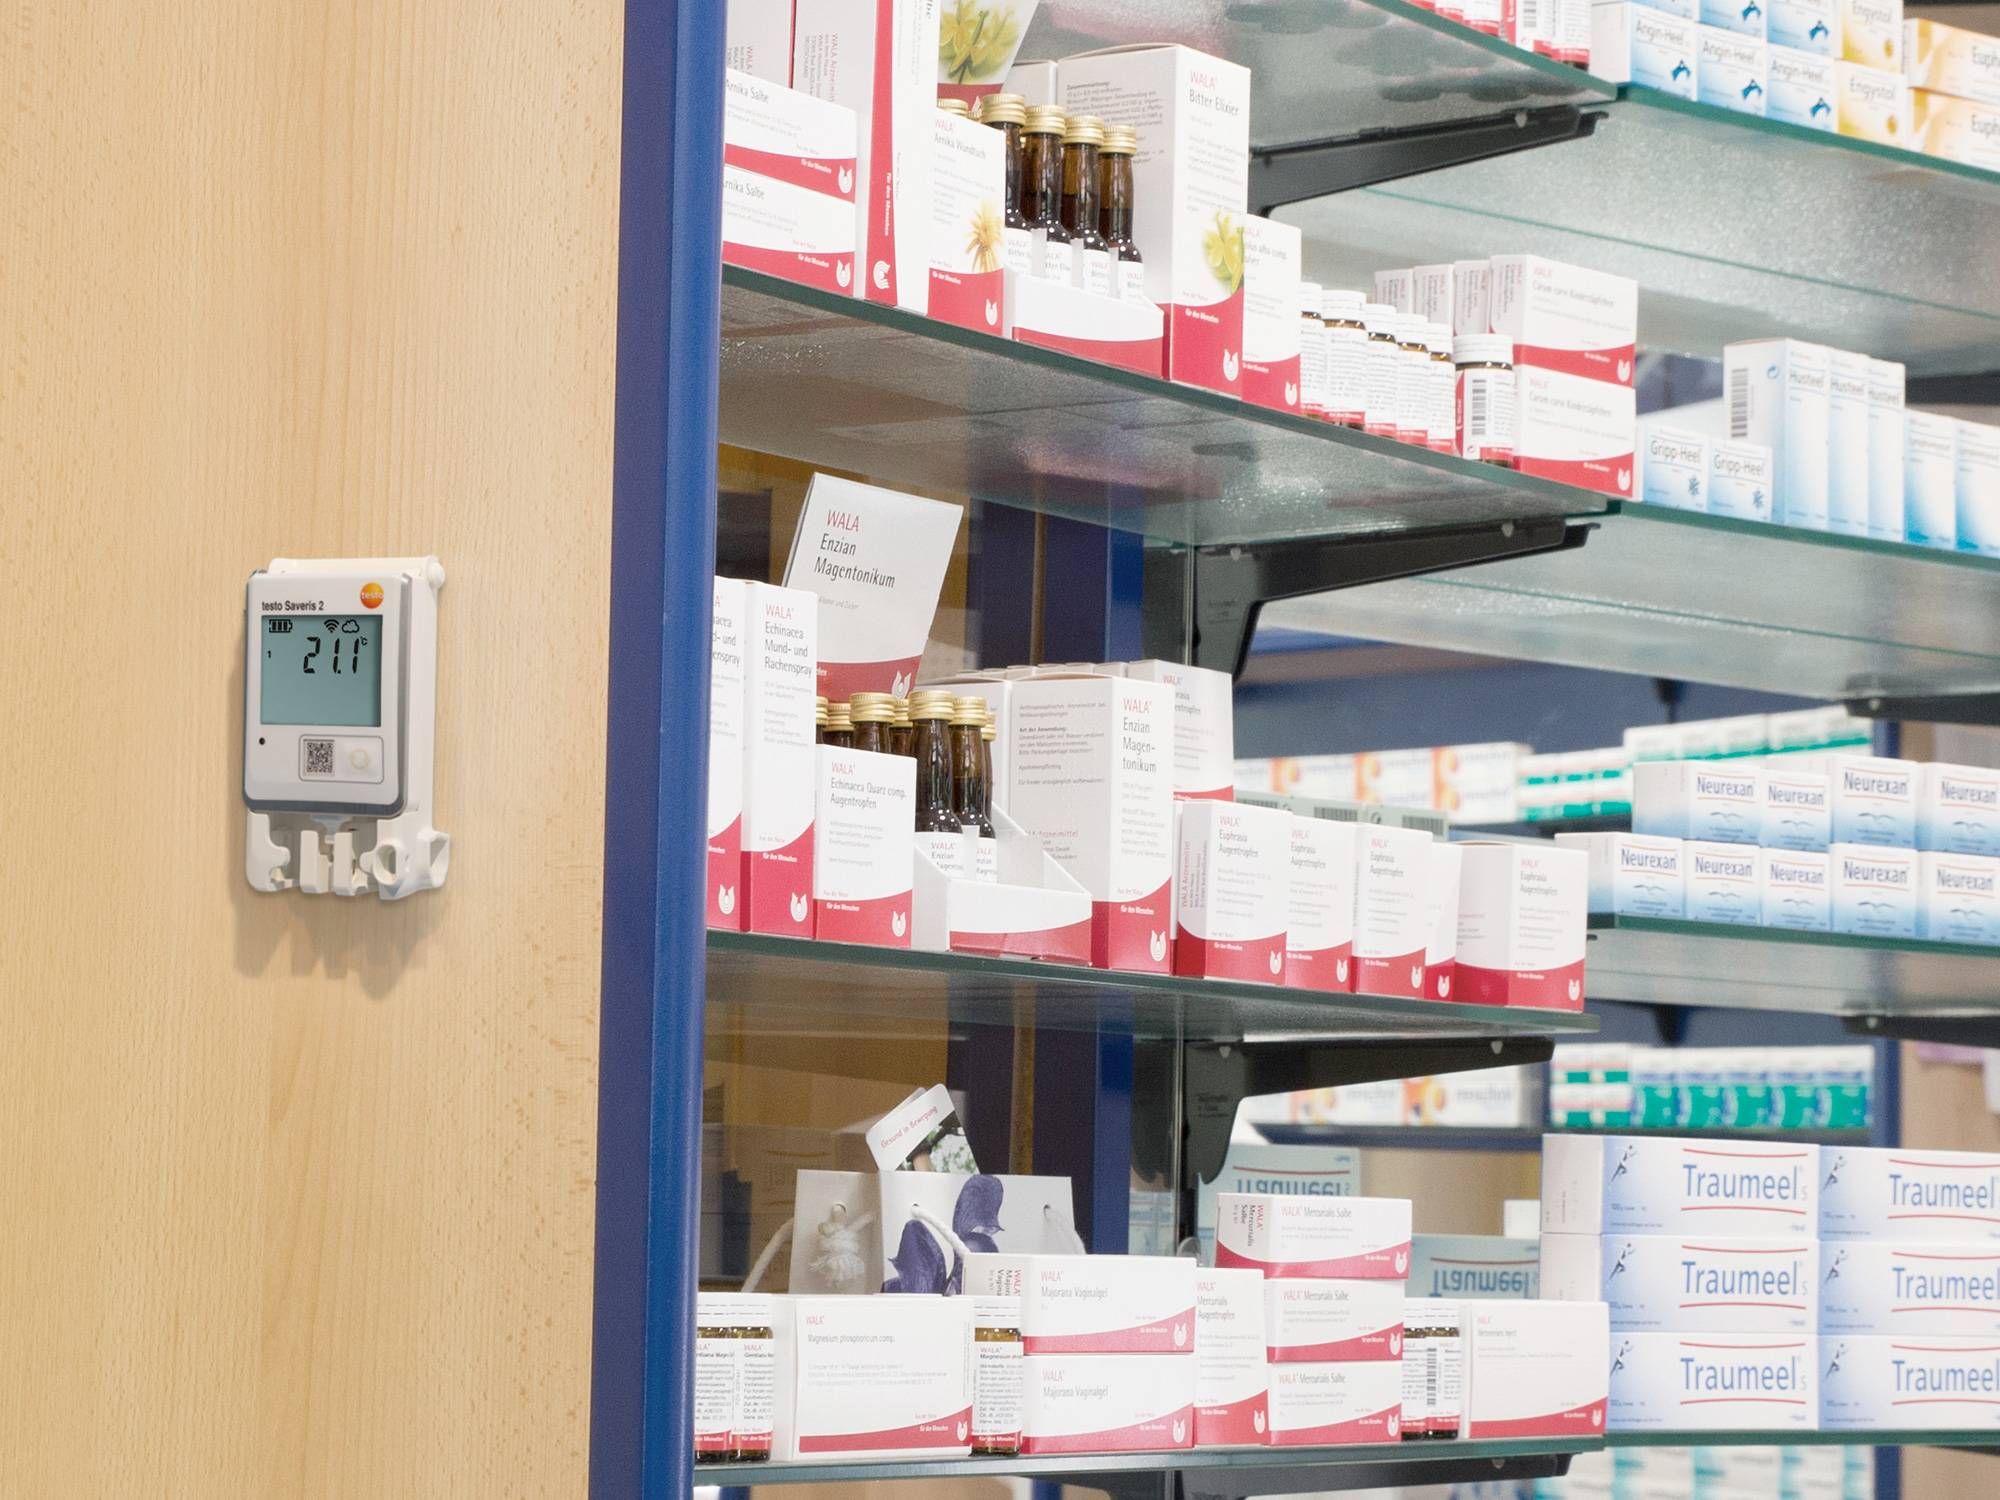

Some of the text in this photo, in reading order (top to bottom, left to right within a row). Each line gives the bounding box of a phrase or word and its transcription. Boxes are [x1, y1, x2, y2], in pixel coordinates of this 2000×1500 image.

[1190, 89, 1240, 116] Bitter Elixier
[1650, 439, 1702, 465] Gripp-Heel
[1714, 454, 1765, 477] Gripp-Heel
[827, 510, 860, 532] WALA
[821, 533, 856, 555] Enzian
[815, 557, 895, 588] Magentonikum
[262, 601, 324, 611] testo Saveris 2
[766, 604, 792, 619] WALA
[723, 633, 736, 645] und
[765, 622, 804, 639] Echinacea
[268, 650, 271, 658] 1
[765, 640, 808, 657] Mund- und
[765, 657, 812, 676] Rachenspray
[1123, 718, 1150, 733] Enzian
[1123, 737, 1156, 754] Magen-
[832, 762, 855, 774] WALA
[1122, 758, 1157, 773] tonikum
[831, 778, 906, 799] Echinacea Quarz comp.
[1697, 777, 1754, 796] Neurexan
[1845, 772, 1908, 795] Neurexan
[1941, 781, 1997, 803] Neurexan
[831, 794, 877, 809] Augentropfen
[1769, 786, 1825, 805] Neurexan
[1621, 849, 1677, 869] Neurexan
[1696, 856, 1752, 877] Neurexan
[1770, 864, 1825, 882] Neurexan
[1844, 862, 1908, 883] Neurexan
[1937, 869, 1994, 890] Neurexan
[1683, 1164, 1798, 1200] Traumeel
[1889, 1174, 1994, 1209] Traumeel
[1682, 1261, 1798, 1297] Traumeel
[1892, 1267, 2000, 1299] Traumeel
[1041, 1287, 1072, 1298] Majorana
[1680, 1356, 1797, 1391] Traumeel
[1892, 1359, 2000, 1392] Traumeel
